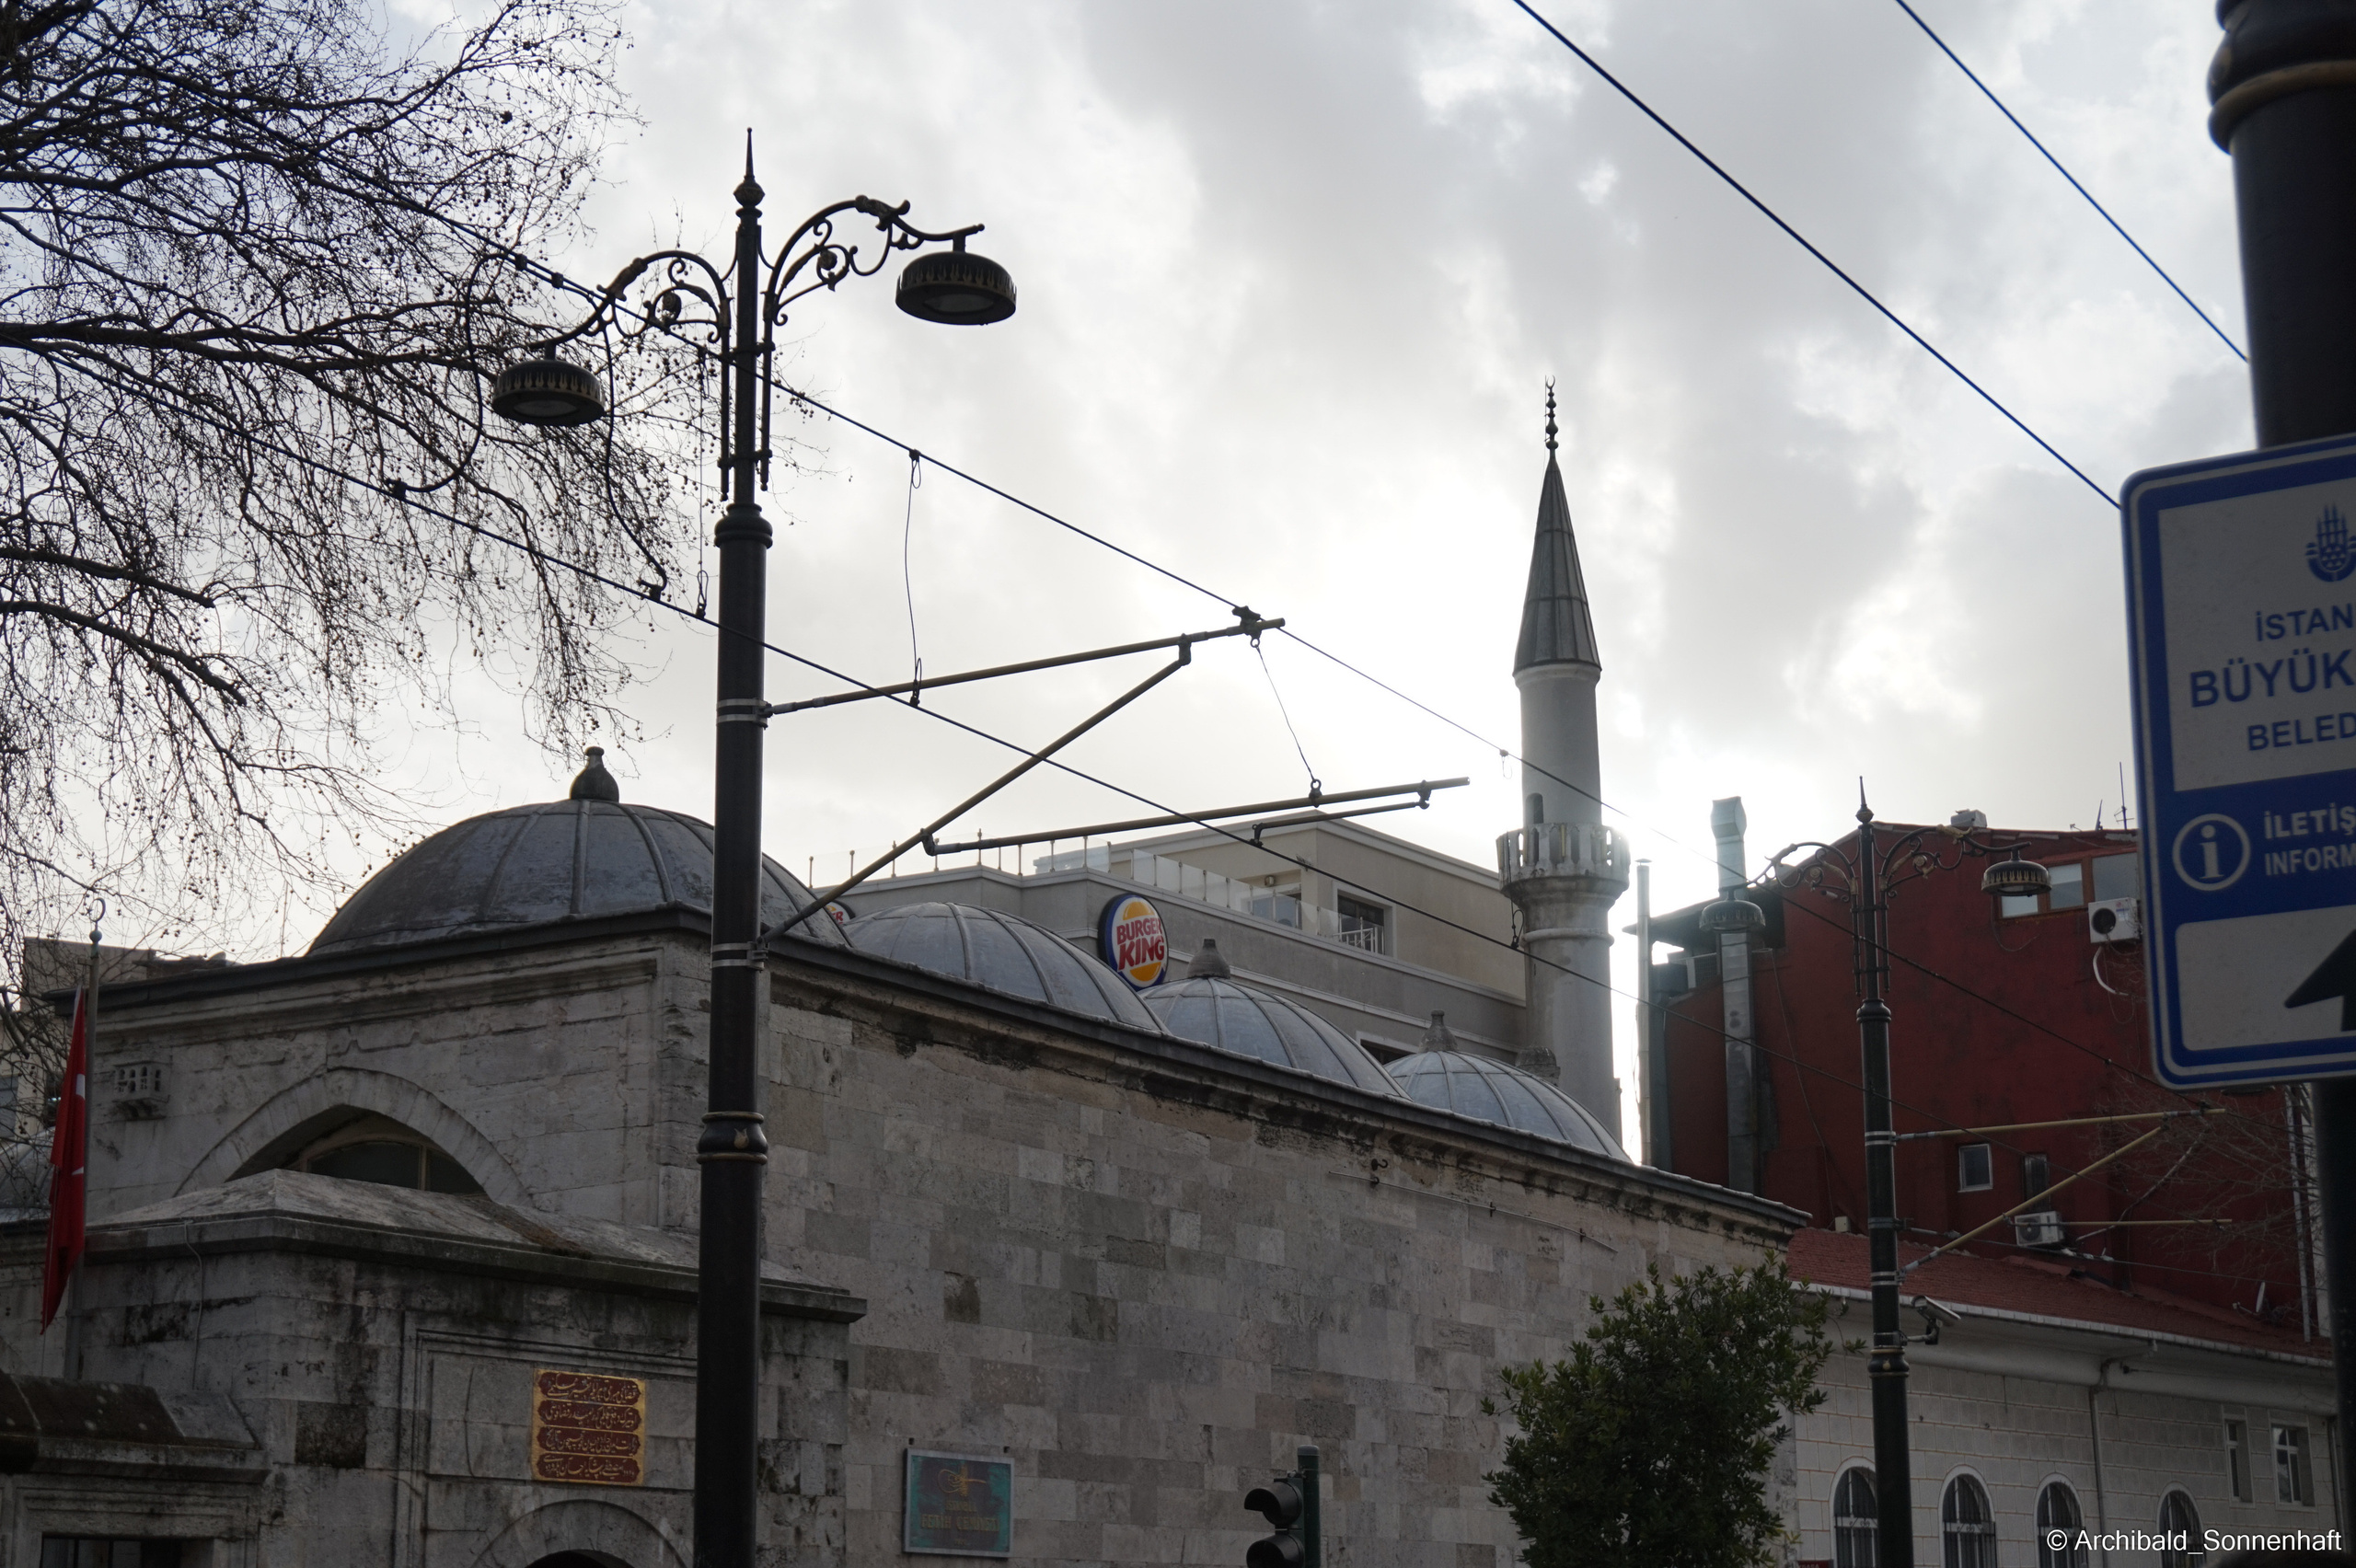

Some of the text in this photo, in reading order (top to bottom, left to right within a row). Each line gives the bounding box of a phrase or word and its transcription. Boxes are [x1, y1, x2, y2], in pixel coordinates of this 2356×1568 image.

[2256, 603, 2354, 641] İSTAN
[2189, 647, 2355, 708] BÜYÜK
[2246, 711, 2356, 751] BELED
[2264, 802, 2356, 839] İLETİŞ
[1116, 917, 1163, 945] BURGER
[1118, 935, 1165, 971] KING
